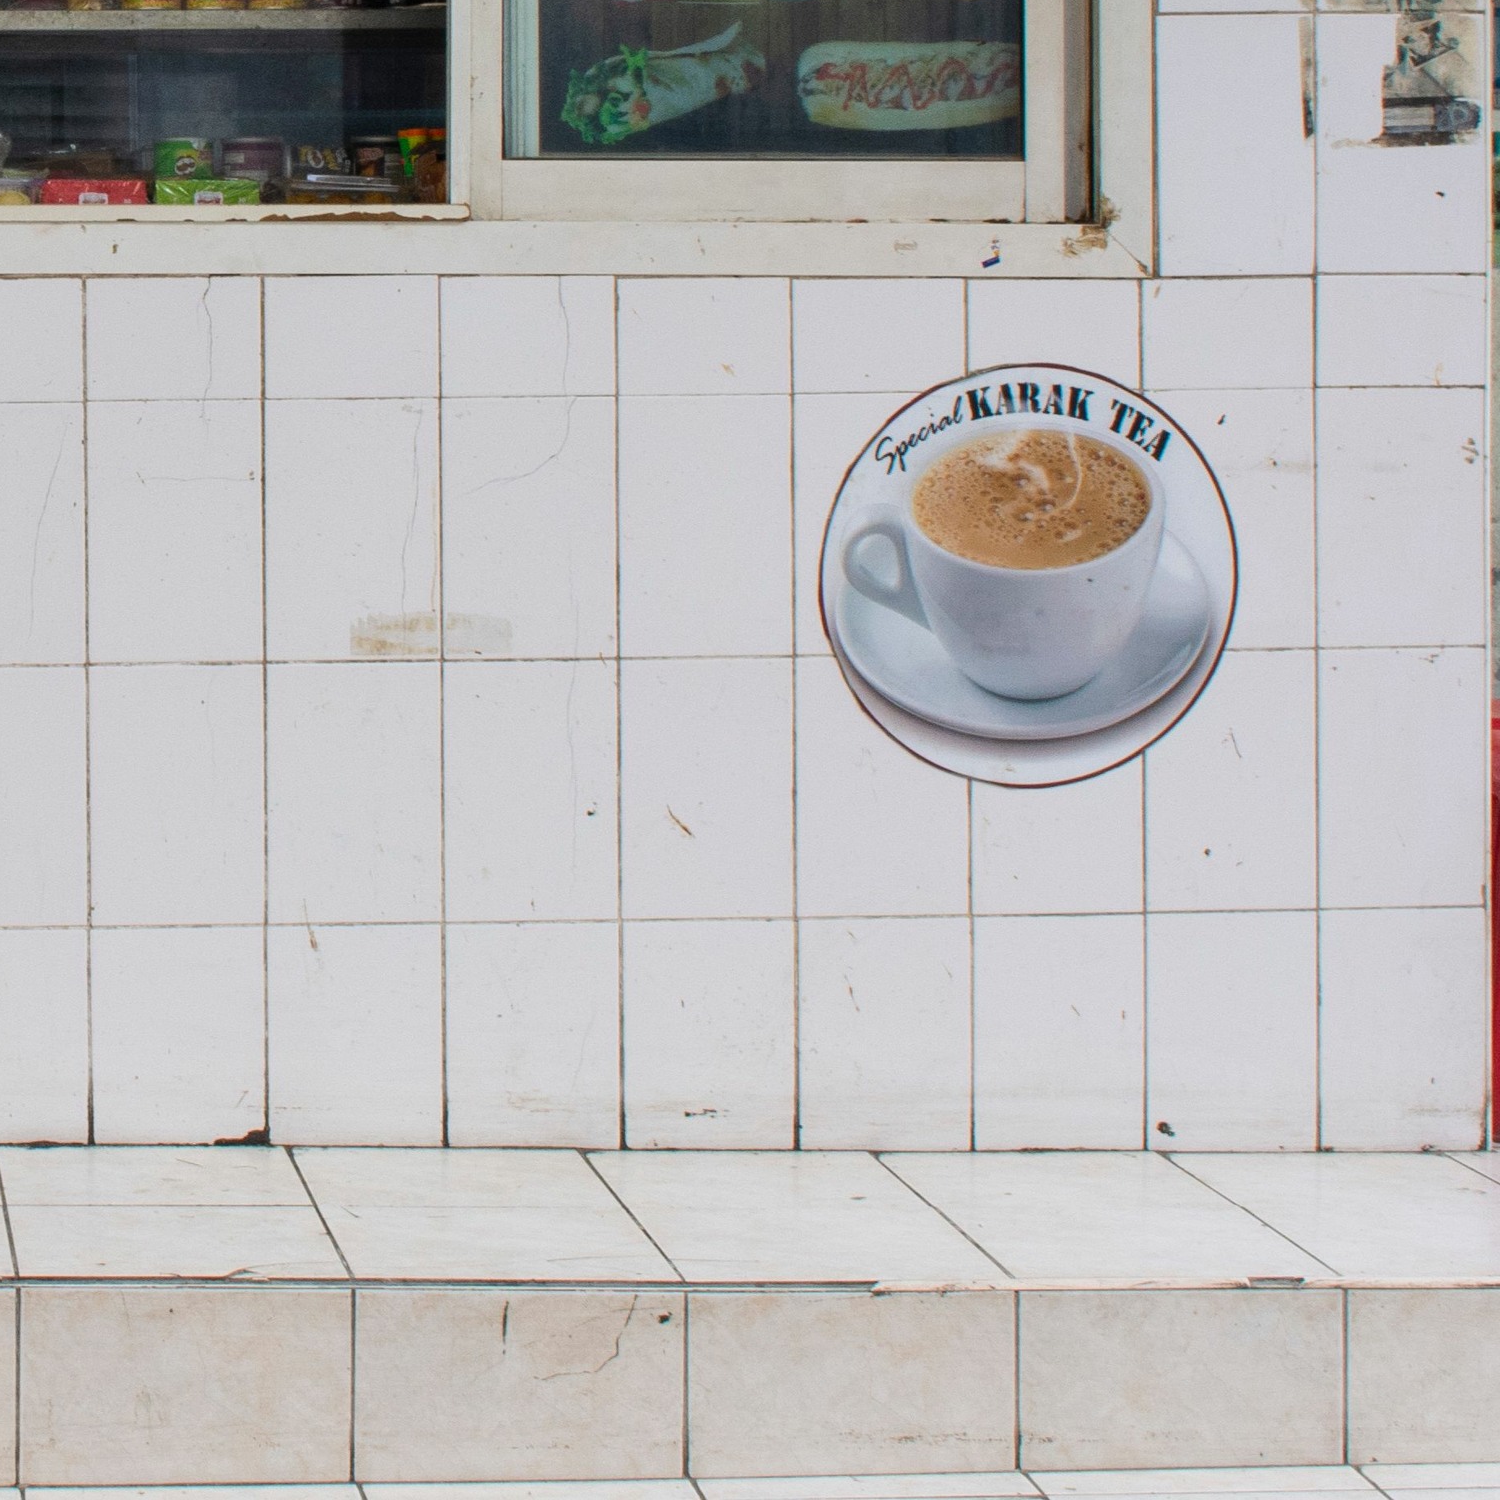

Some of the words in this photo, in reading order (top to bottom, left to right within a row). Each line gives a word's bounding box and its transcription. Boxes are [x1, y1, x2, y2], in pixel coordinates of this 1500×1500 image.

[874, 395, 964, 476] Special
[966, 381, 1096, 422] KARAK
[1109, 397, 1173, 463] TEA
